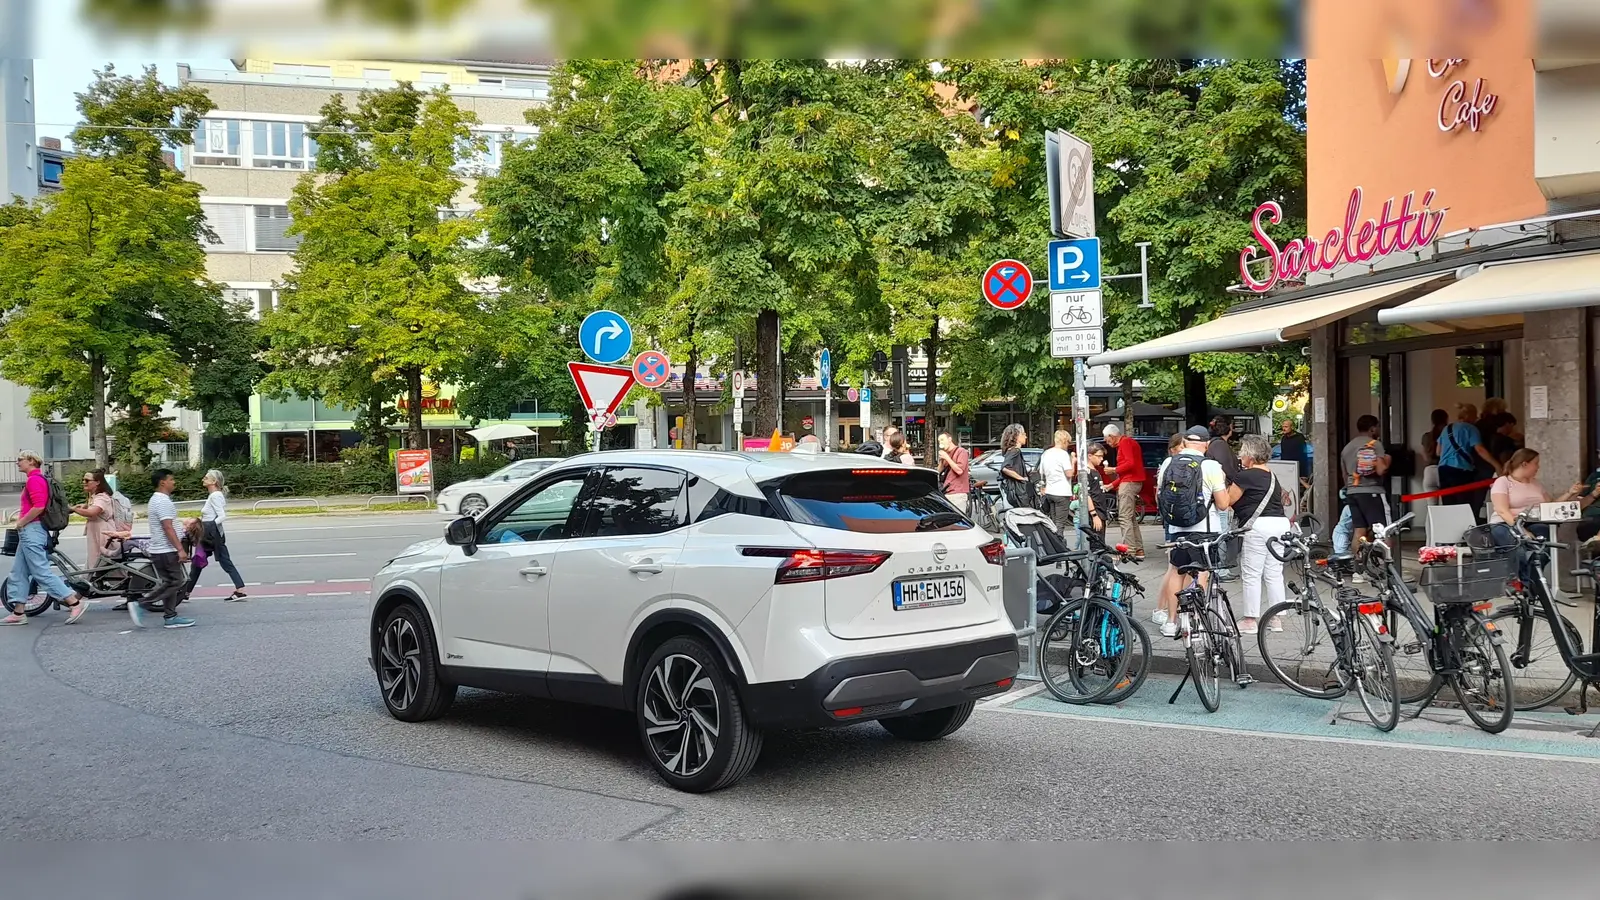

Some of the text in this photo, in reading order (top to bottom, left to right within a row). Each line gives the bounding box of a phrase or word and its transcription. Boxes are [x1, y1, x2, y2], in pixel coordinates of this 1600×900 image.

[1438, 78, 1498, 132] Cafe
[1240, 186, 1447, 293] Sarcletti
[1057, 246, 1084, 284] P
[1066, 294, 1085, 303] nur
[1056, 344, 1069, 352] mit
[861, 391, 868, 401] P
[908, 564, 966, 574] QASHQAI
[902, 580, 963, 602] HH EN 156
